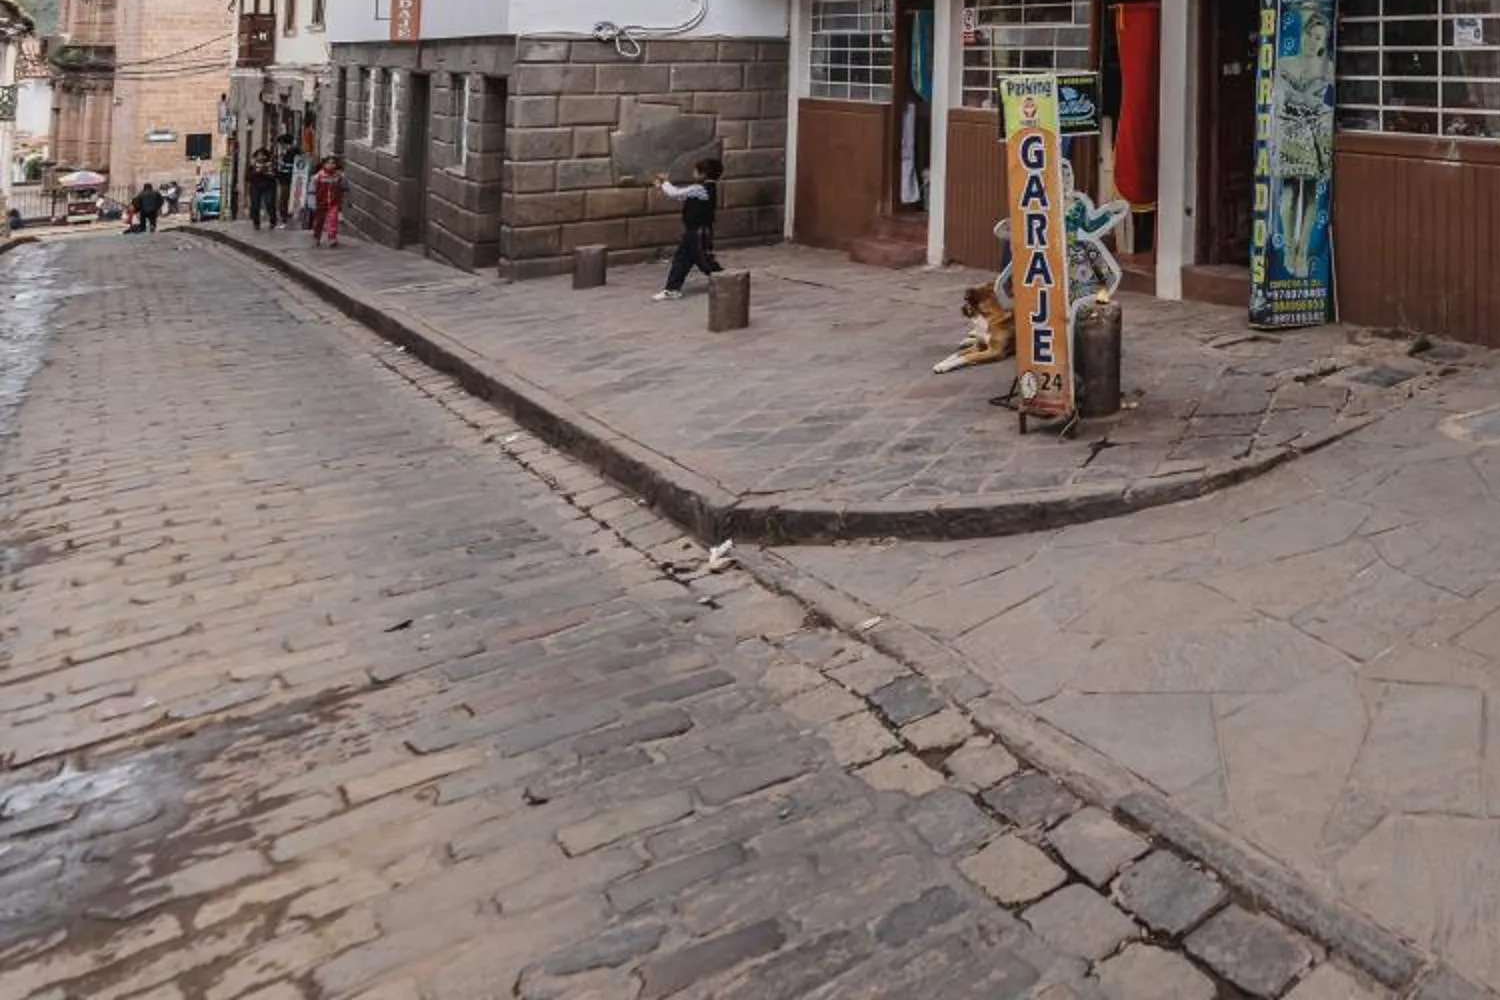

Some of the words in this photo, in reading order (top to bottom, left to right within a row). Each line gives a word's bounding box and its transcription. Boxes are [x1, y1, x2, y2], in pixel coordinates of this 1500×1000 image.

[1006, 77, 1052, 97] Parking
[1251, 8, 1276, 284] BORDADOS
[1018, 133, 1055, 365] GARAJE
[1040, 371, 1063, 392] 24
